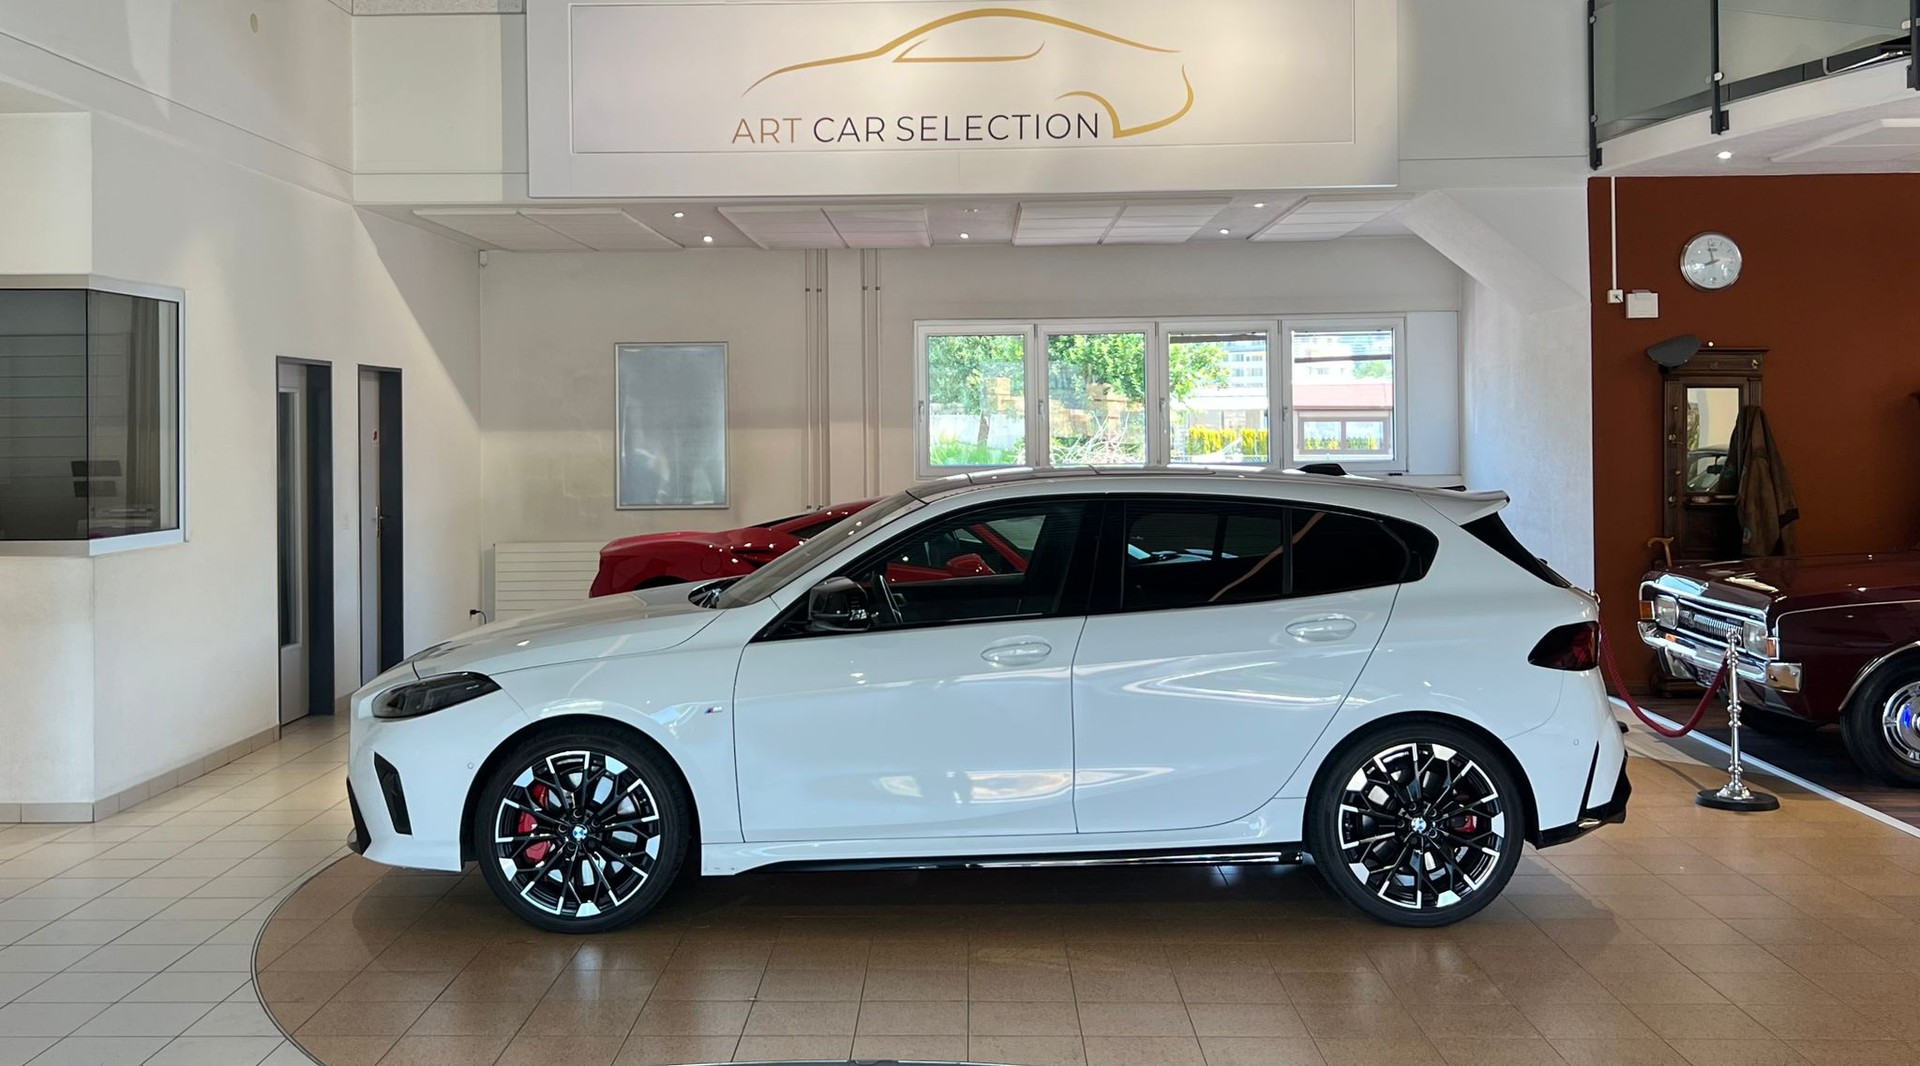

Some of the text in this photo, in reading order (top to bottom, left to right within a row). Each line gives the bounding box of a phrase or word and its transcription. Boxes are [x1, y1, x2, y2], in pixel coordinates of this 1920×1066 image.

[732, 113, 1099, 144] ART CAR SELECTION
